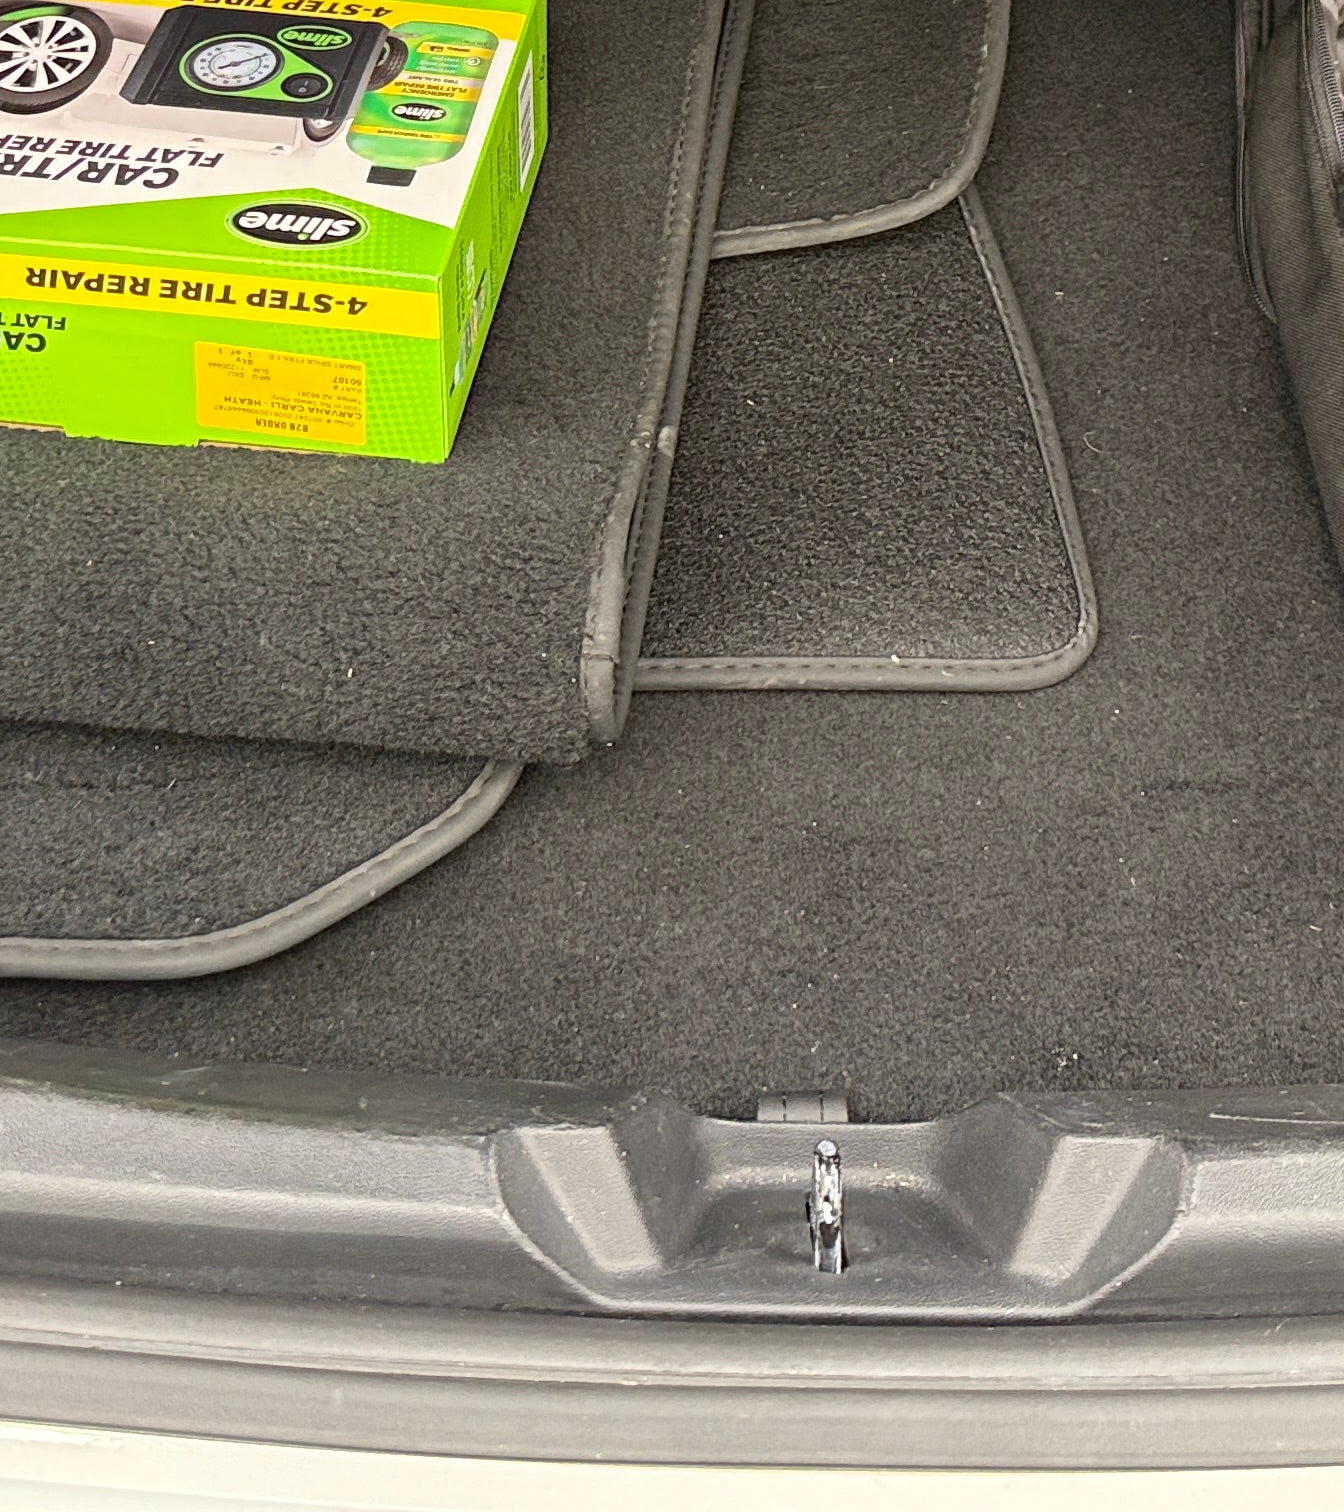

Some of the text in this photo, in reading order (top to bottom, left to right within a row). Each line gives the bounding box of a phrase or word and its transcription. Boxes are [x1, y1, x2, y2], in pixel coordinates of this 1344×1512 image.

[282, 0, 392, 18] 4-STEP
[282, 32, 345, 46] slime
[400, 88, 454, 98] EMERGENCY
[394, 105, 444, 120] slime
[56, 139, 130, 160] TIRE
[136, 145, 224, 168] FLAT
[238, 210, 356, 240] slime
[24, 267, 368, 316] 4-STEP TIRE REPAIR
[11, 314, 66, 330] FLAT
[236, 357, 253, 366] Qty
[224, 396, 261, 406] HEATH
[308, 406, 362, 420] CARVANA
[256, 418, 286, 429] ORDER
